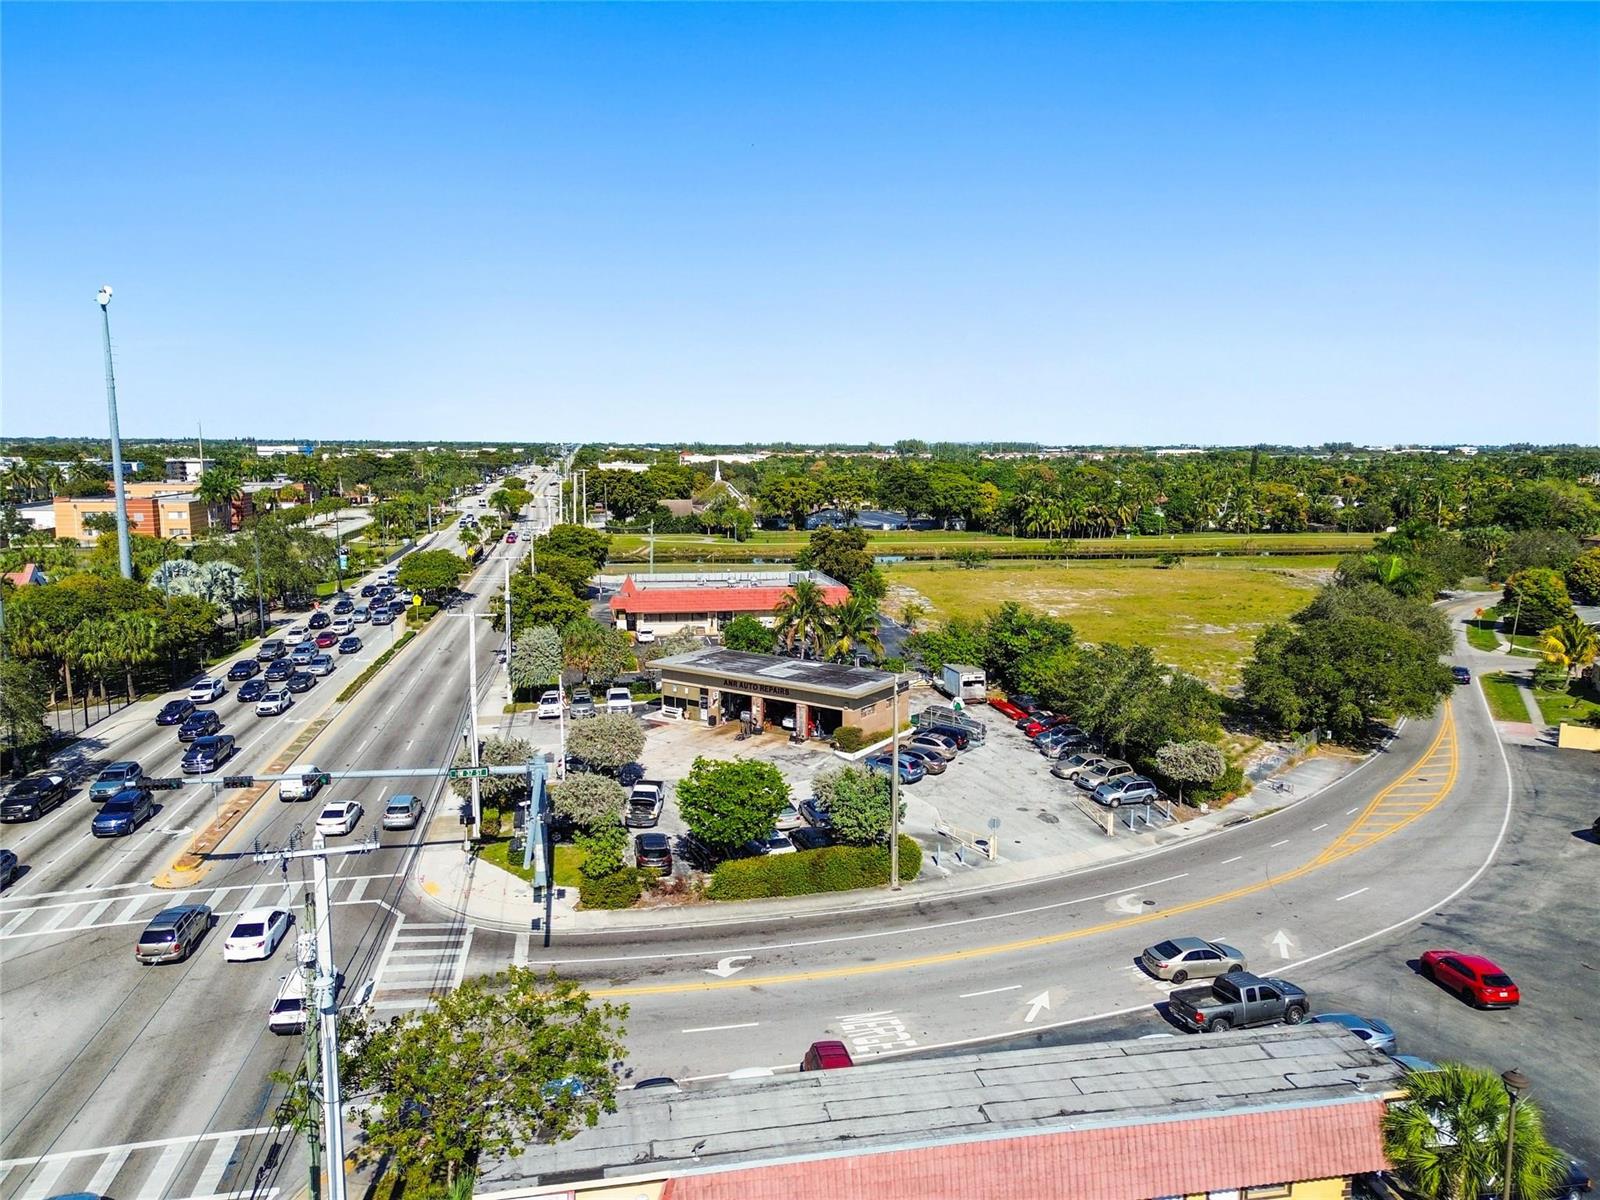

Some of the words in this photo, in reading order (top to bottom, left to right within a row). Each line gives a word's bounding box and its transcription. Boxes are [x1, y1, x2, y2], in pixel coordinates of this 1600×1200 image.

[738, 682, 759, 691] AUTO
[759, 684, 790, 696] REPAIRS
[835, 1010, 918, 1054] MERGE
